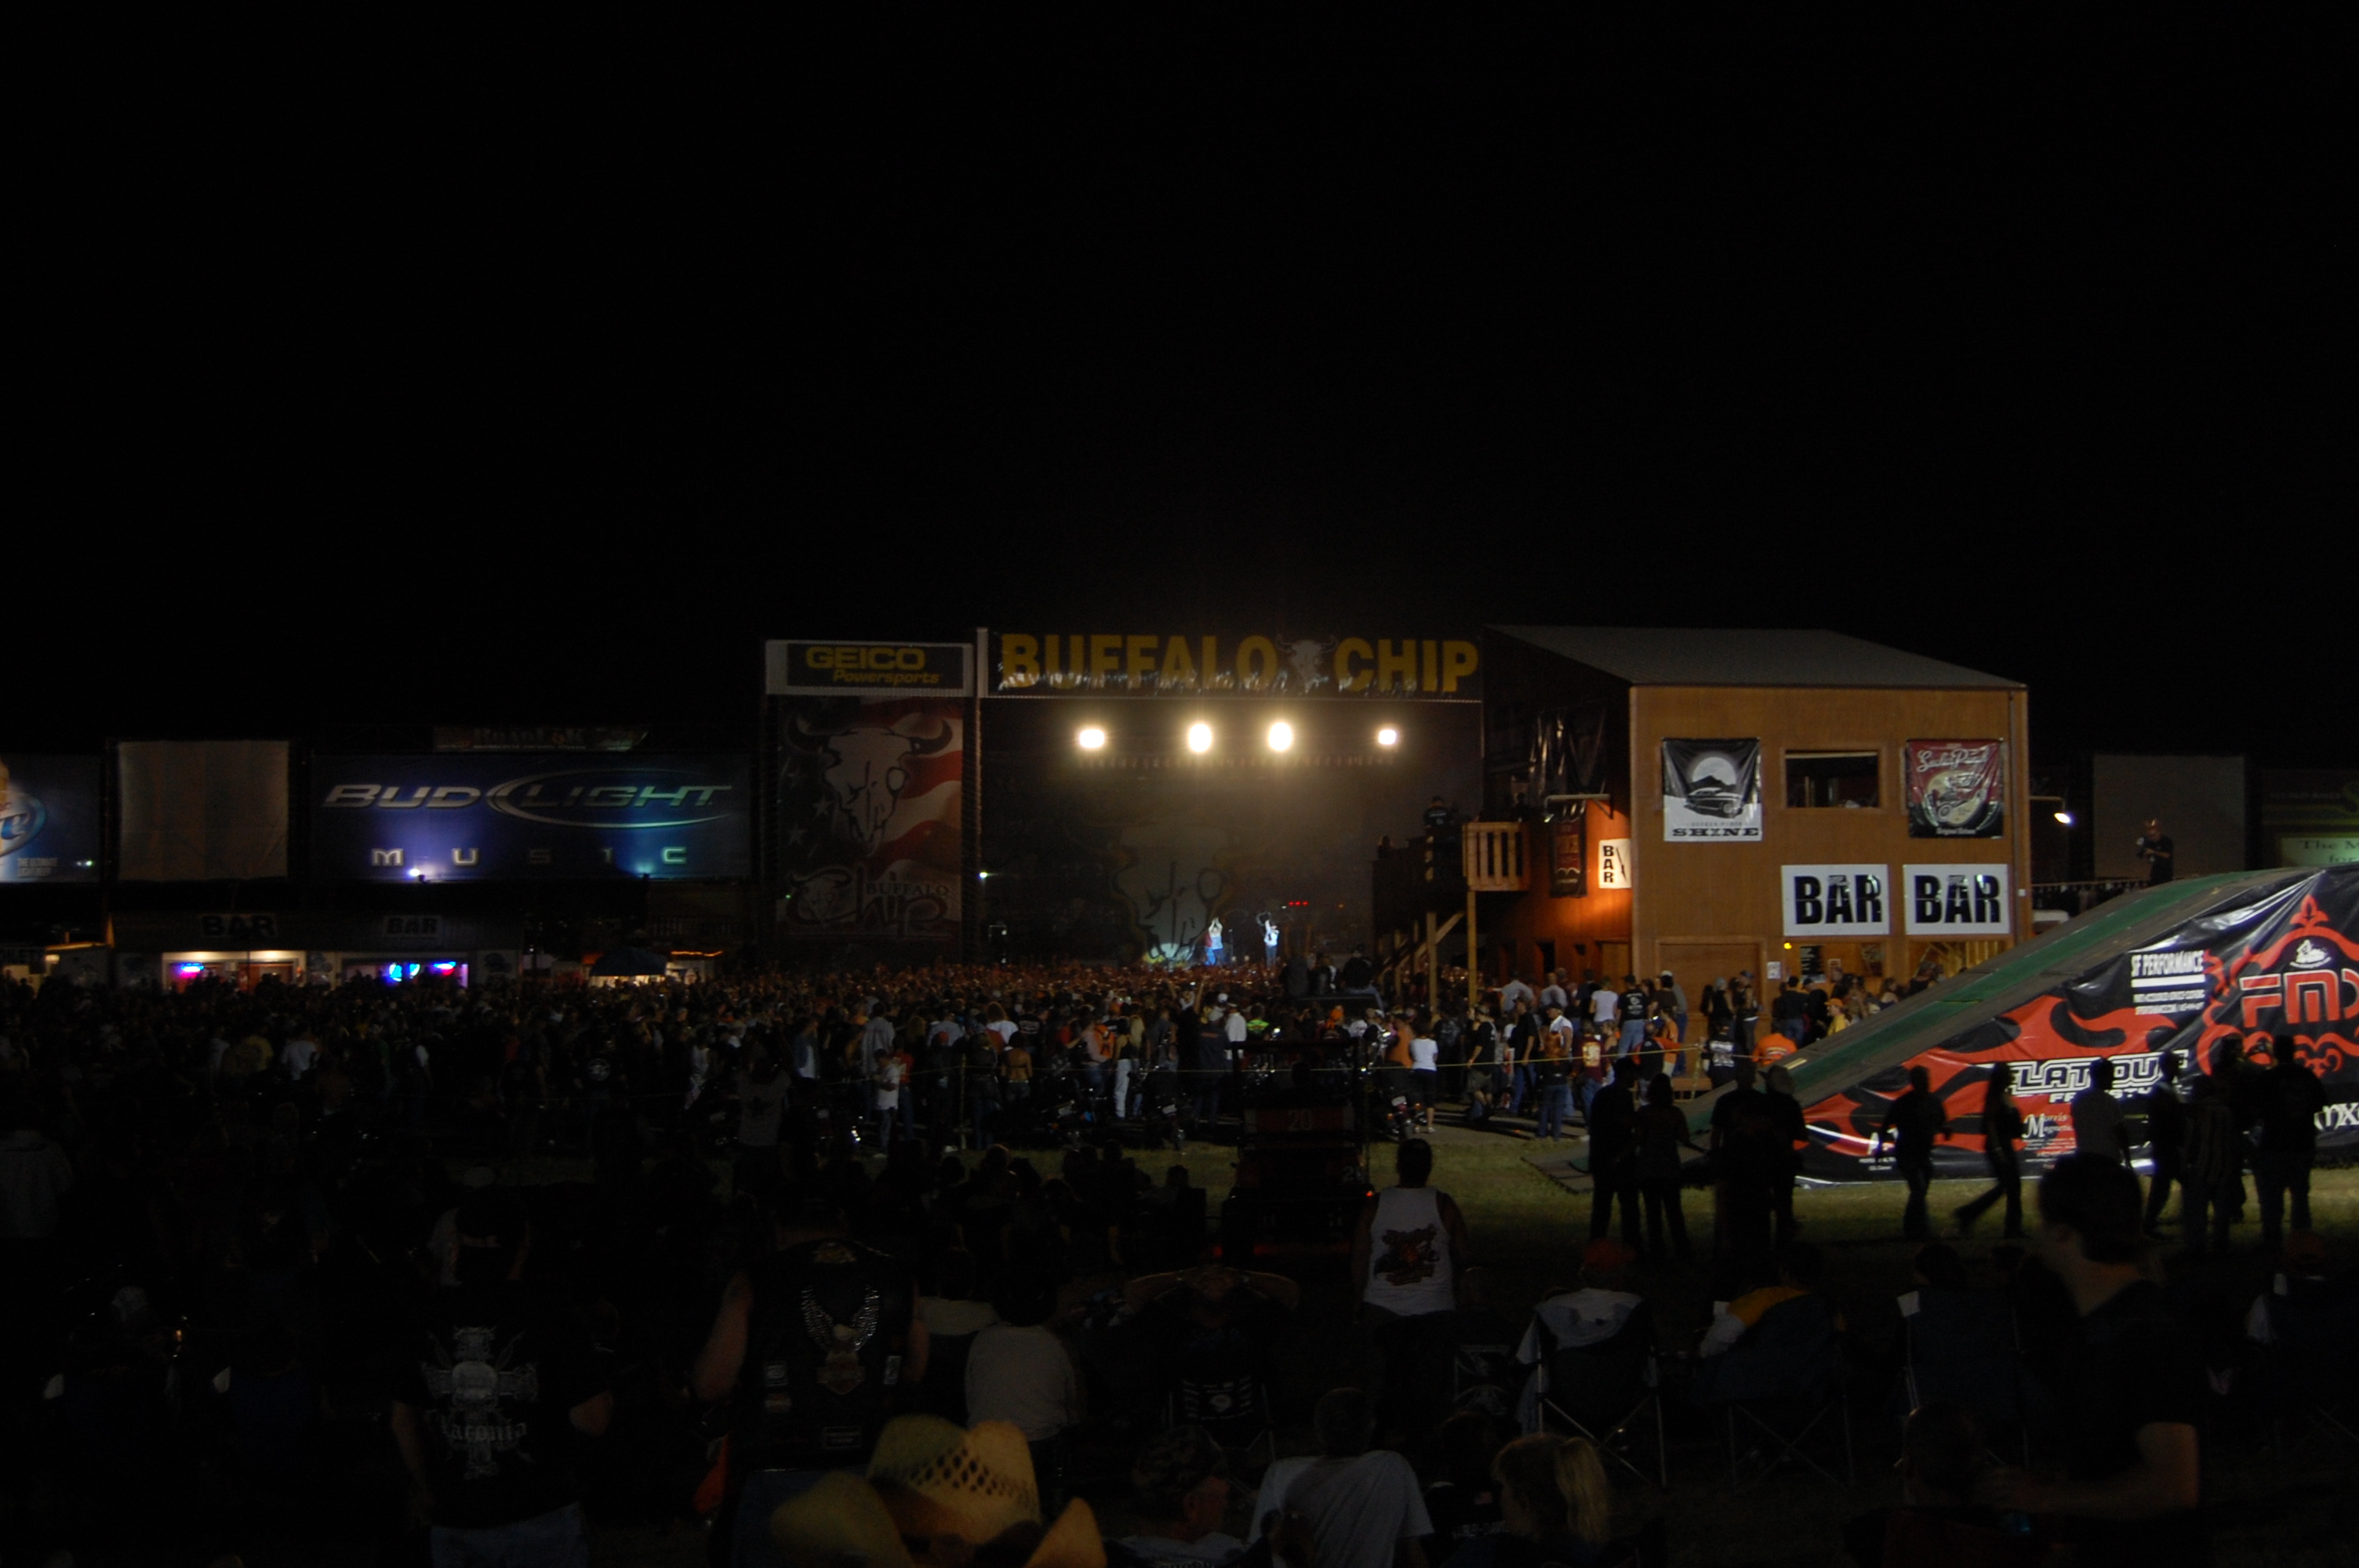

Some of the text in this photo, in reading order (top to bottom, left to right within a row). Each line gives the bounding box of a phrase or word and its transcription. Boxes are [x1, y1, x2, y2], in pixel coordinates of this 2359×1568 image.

[805, 645, 926, 670] GEICO
[1001, 633, 1479, 693] BUFFALO CHIP
[833, 668, 940, 687] Powersports
[322, 784, 732, 808] BUD LIGHT
[1672, 828, 1759, 837] SHINE
[372, 847, 687, 866] MUSIC
[1603, 845, 1614, 883] BAR
[1794, 874, 1881, 924] BAR
[1914, 874, 2000, 923] BAR
[202, 915, 274, 937] BAR
[387, 918, 438, 935] BAR
